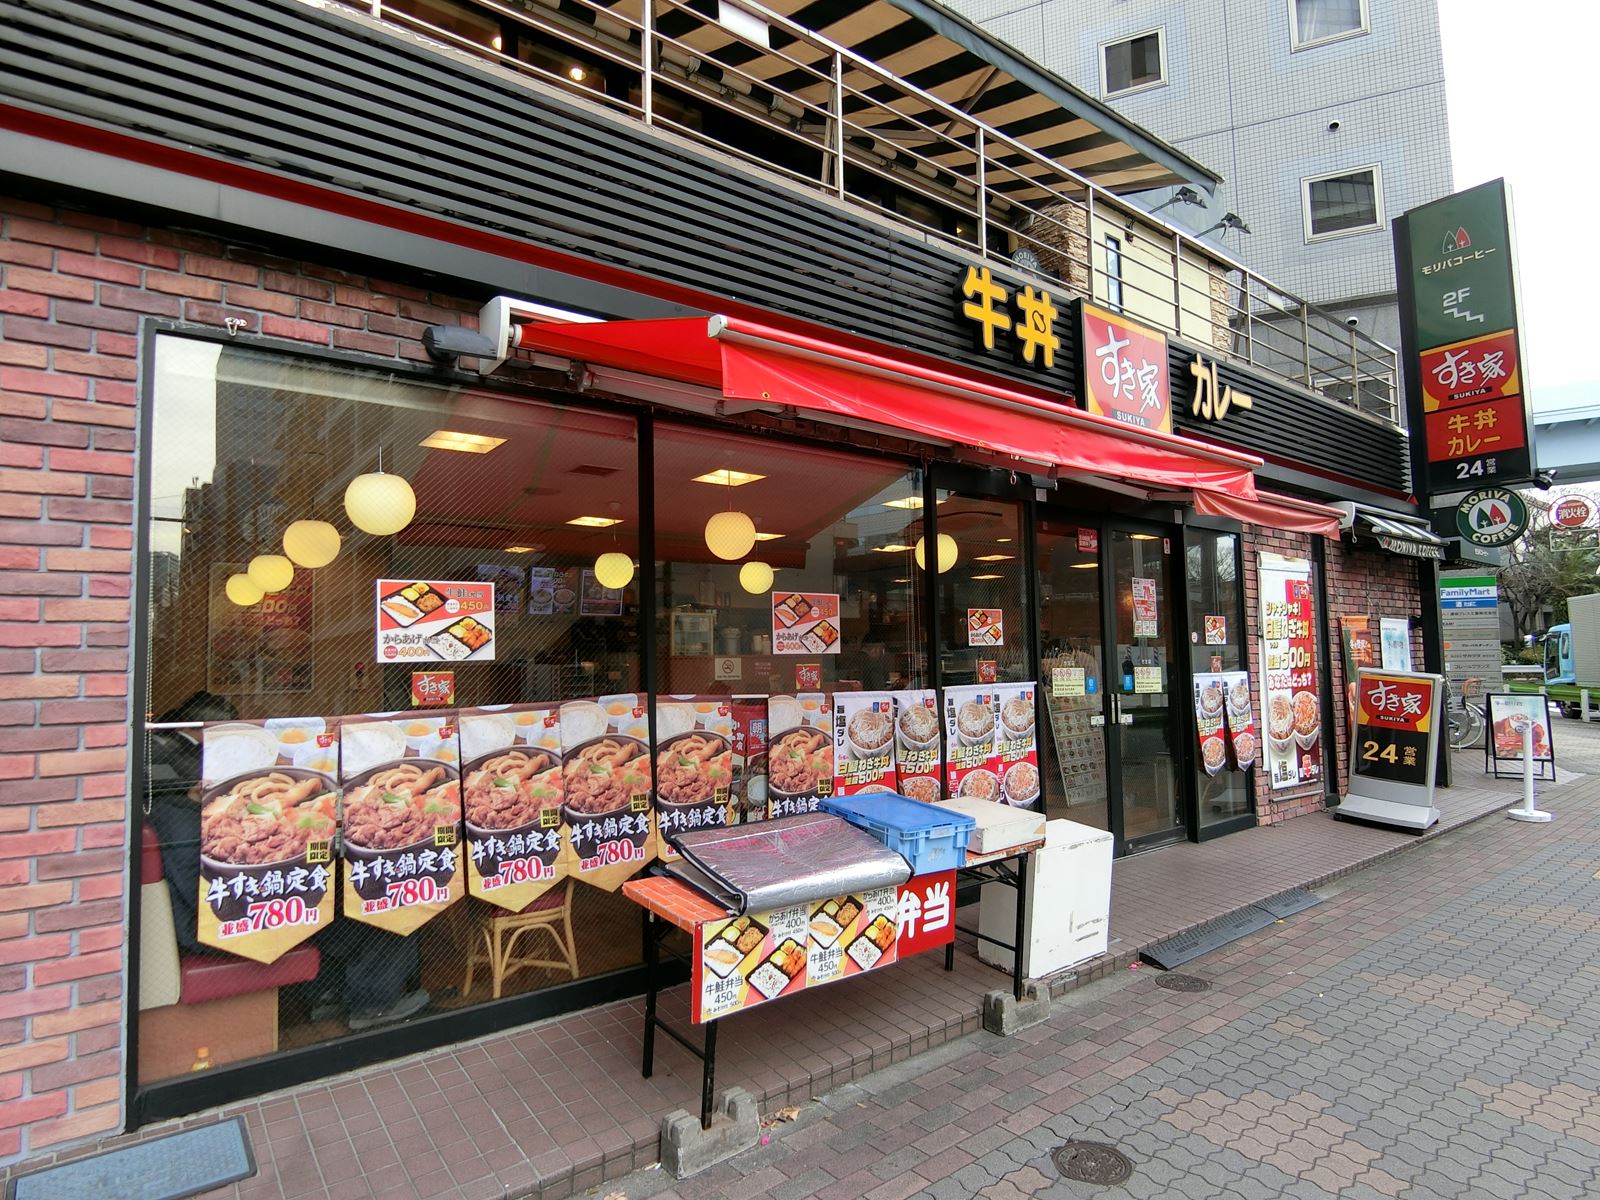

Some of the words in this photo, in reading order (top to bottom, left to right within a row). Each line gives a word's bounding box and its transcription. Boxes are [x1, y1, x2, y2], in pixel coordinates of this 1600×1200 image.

[1014, 252, 1037, 268] MORIVA
[1421, 247, 1496, 275] モリバコーヒー
[1443, 286, 1471, 307] 2F
[963, 265, 1060, 368] 牛丼
[1094, 325, 1161, 413] すき家
[1431, 349, 1506, 389] すき家
[1190, 353, 1253, 421] カレー
[1453, 388, 1487, 400] SUKIYA
[1116, 411, 1147, 427] SUKIYA
[1447, 407, 1498, 434] 牛丼
[1447, 435, 1501, 457] カレー
[1456, 460, 1484, 479] 24
[1460, 489, 1511, 515] MORIVA
[1558, 506, 1588, 519] 消火栓
[1390, 539, 1417, 555] MORIVA
[1471, 523, 1519, 547] COFFEE
[1440, 588, 1490, 597] FamilyMart
[417, 674, 450, 696] すき家
[1368, 680, 1422, 716] すき家
[1380, 715, 1405, 723] SUKIYA
[1362, 740, 1398, 764] 24
[1403, 746, 1417, 767] 営業
[570, 812, 650, 848] 牛すき鍋定食
[659, 805, 728, 834] 牛すき鍋定食
[309, 841, 329, 851] 期間
[309, 851, 328, 860] 限定
[471, 828, 562, 867] 牛すき鍋定食
[349, 847, 458, 889] 牛すき鍋定食
[205, 864, 331, 910] 牛すき鍋定食
[897, 881, 950, 940] 弁当
[705, 975, 743, 996] 牛鮭弁当
